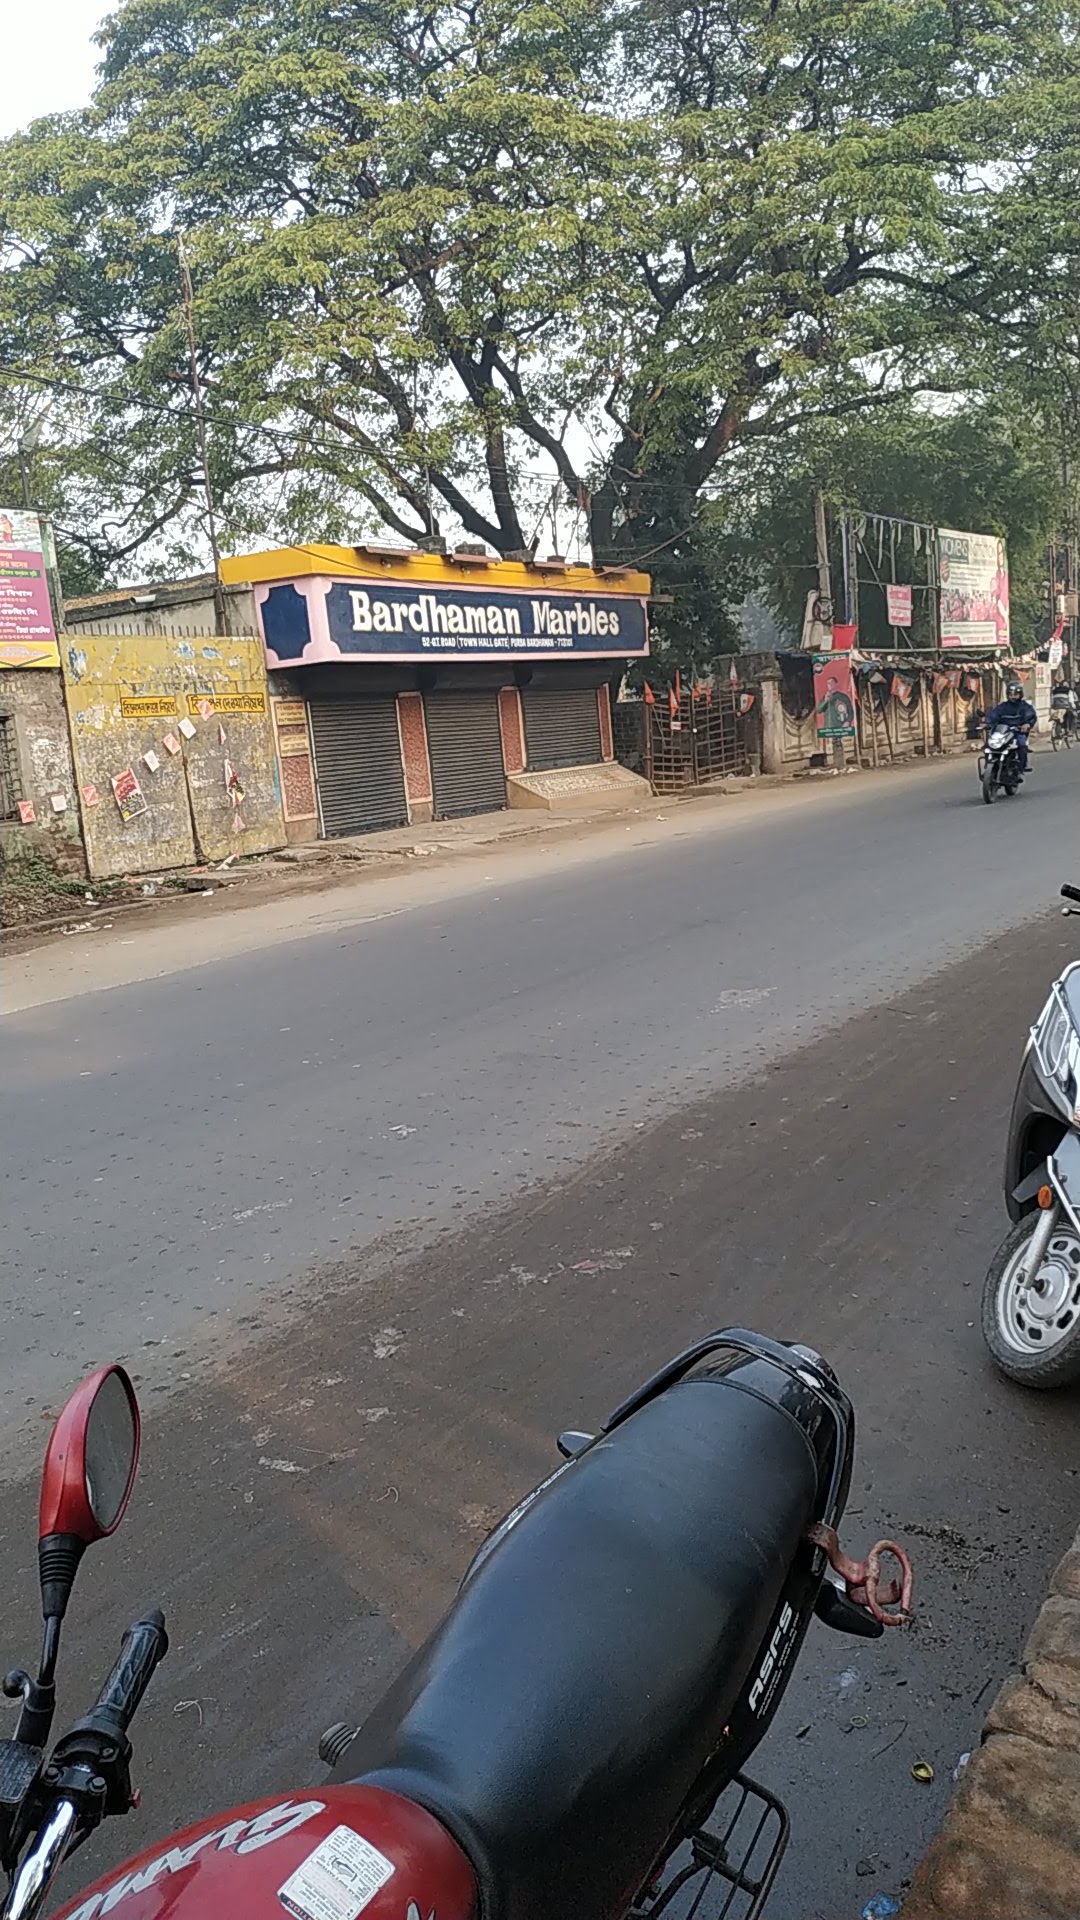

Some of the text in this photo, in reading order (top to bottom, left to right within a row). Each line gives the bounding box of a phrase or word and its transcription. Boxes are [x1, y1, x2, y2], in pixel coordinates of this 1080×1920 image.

[348, 590, 620, 636] Bardhaman Marbles
[440, 637, 456, 647] ROAD
[478, 637, 493, 647] HALL
[748, 1600, 793, 1712] ASFS
